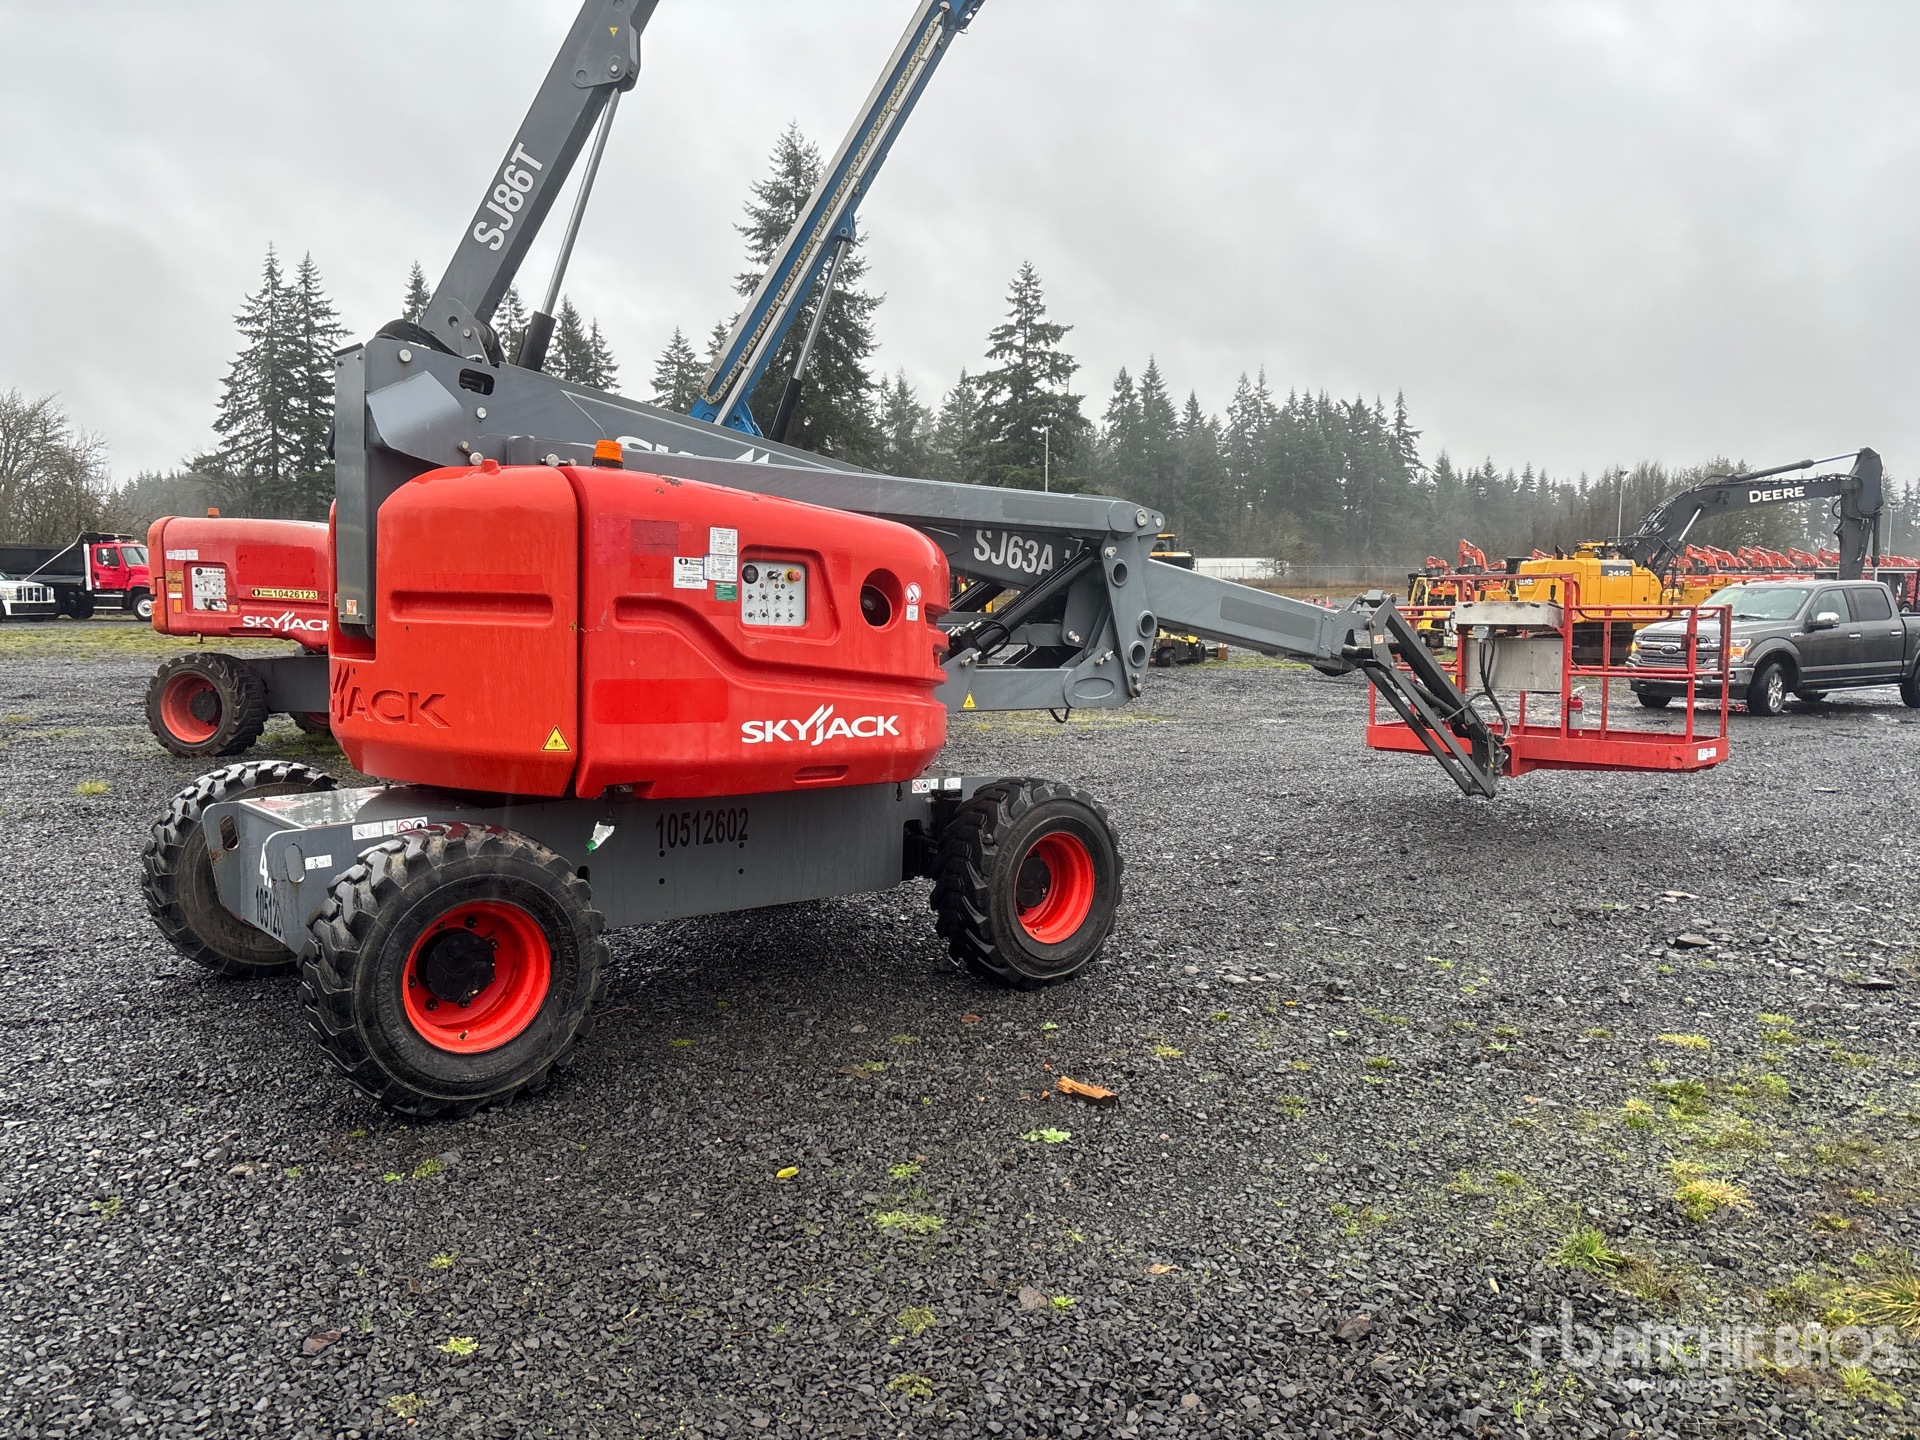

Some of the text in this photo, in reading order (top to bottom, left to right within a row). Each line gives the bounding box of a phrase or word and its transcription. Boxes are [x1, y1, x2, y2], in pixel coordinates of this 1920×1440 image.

[473, 142, 543, 251] SJ86T
[1748, 486, 1806, 503] DEERE
[974, 529, 1071, 576] SJ63A
[273, 590, 317, 599] 10426123
[741, 703, 900, 746] SKYJACK
[655, 807, 749, 850] 10512602
